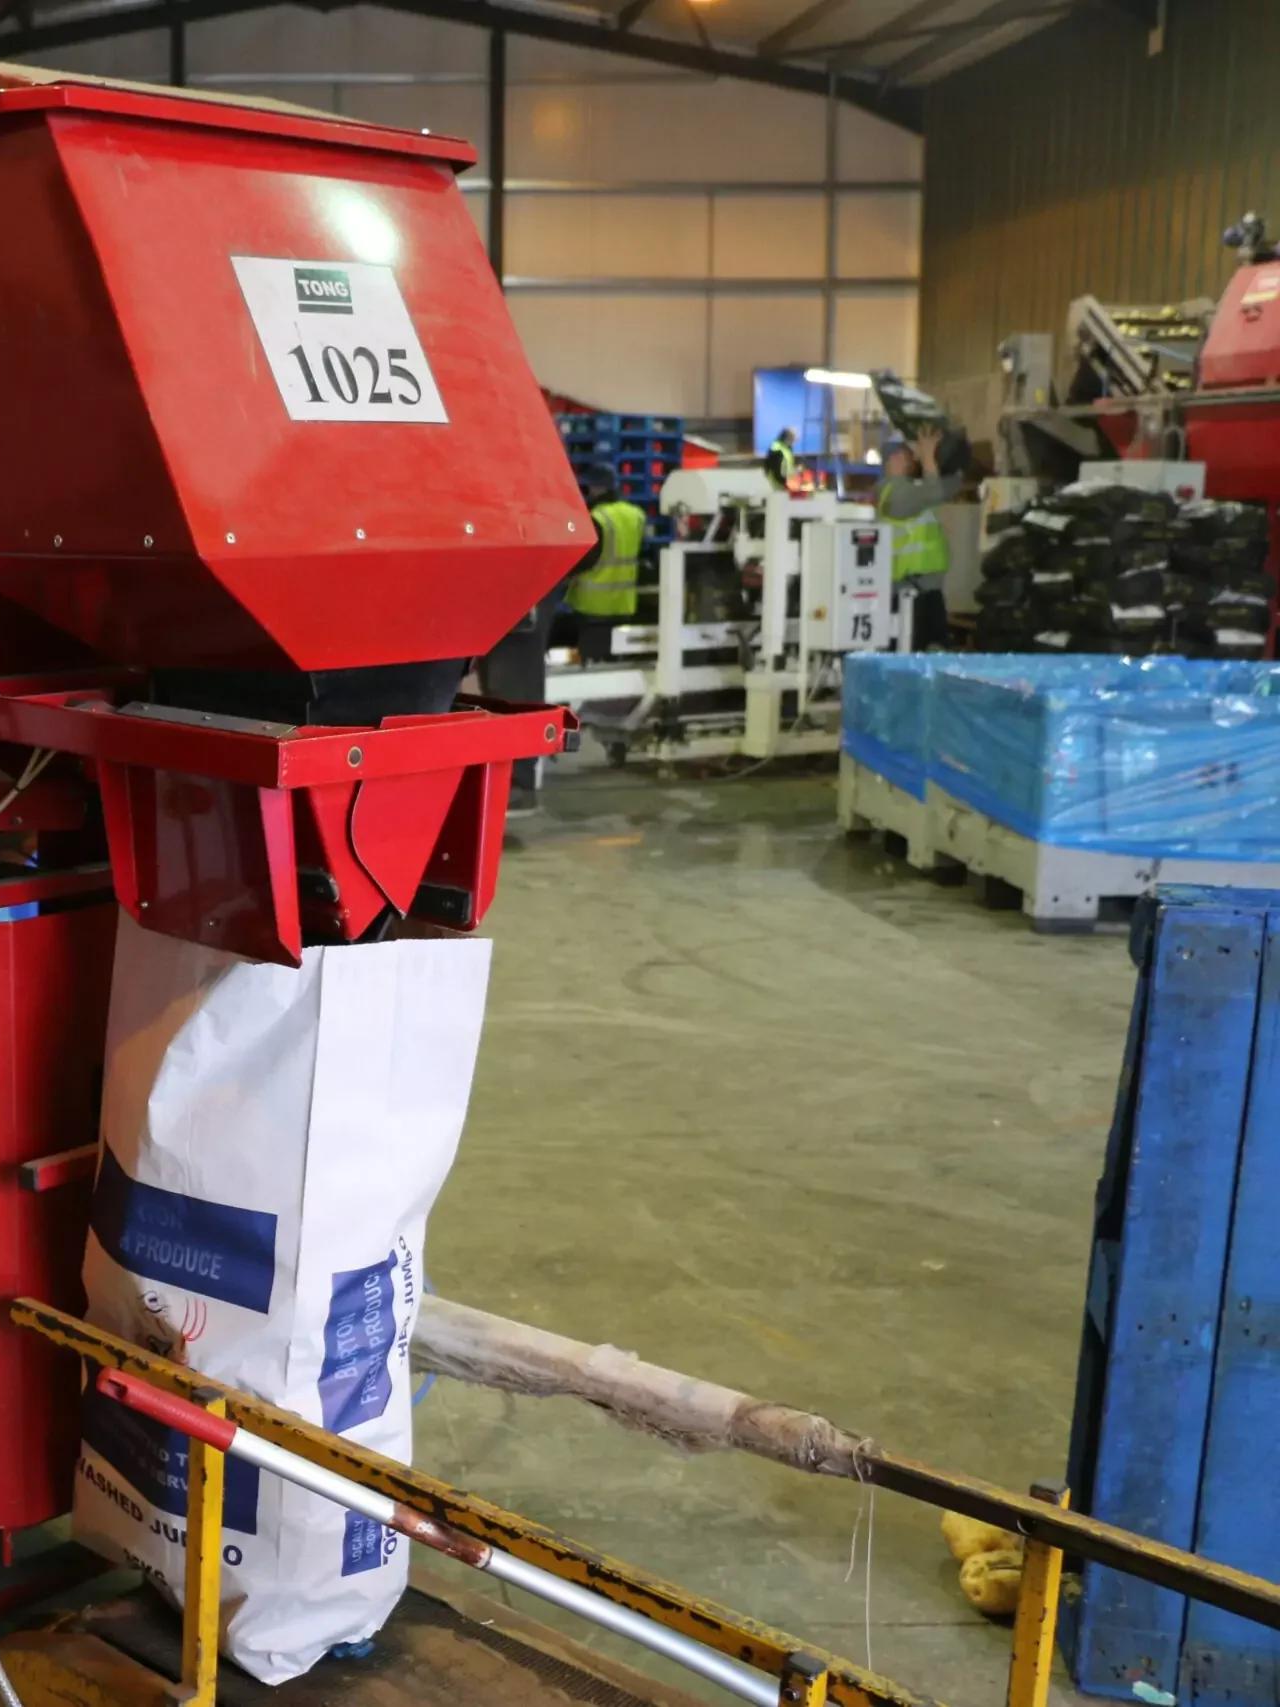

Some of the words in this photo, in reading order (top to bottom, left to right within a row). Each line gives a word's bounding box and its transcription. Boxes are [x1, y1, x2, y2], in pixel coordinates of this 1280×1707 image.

[297, 278, 350, 298] TONG
[286, 344, 423, 406] 1025
[135, 1232, 225, 1281] PRODUCE
[351, 1519, 364, 1563] LOCALLY
